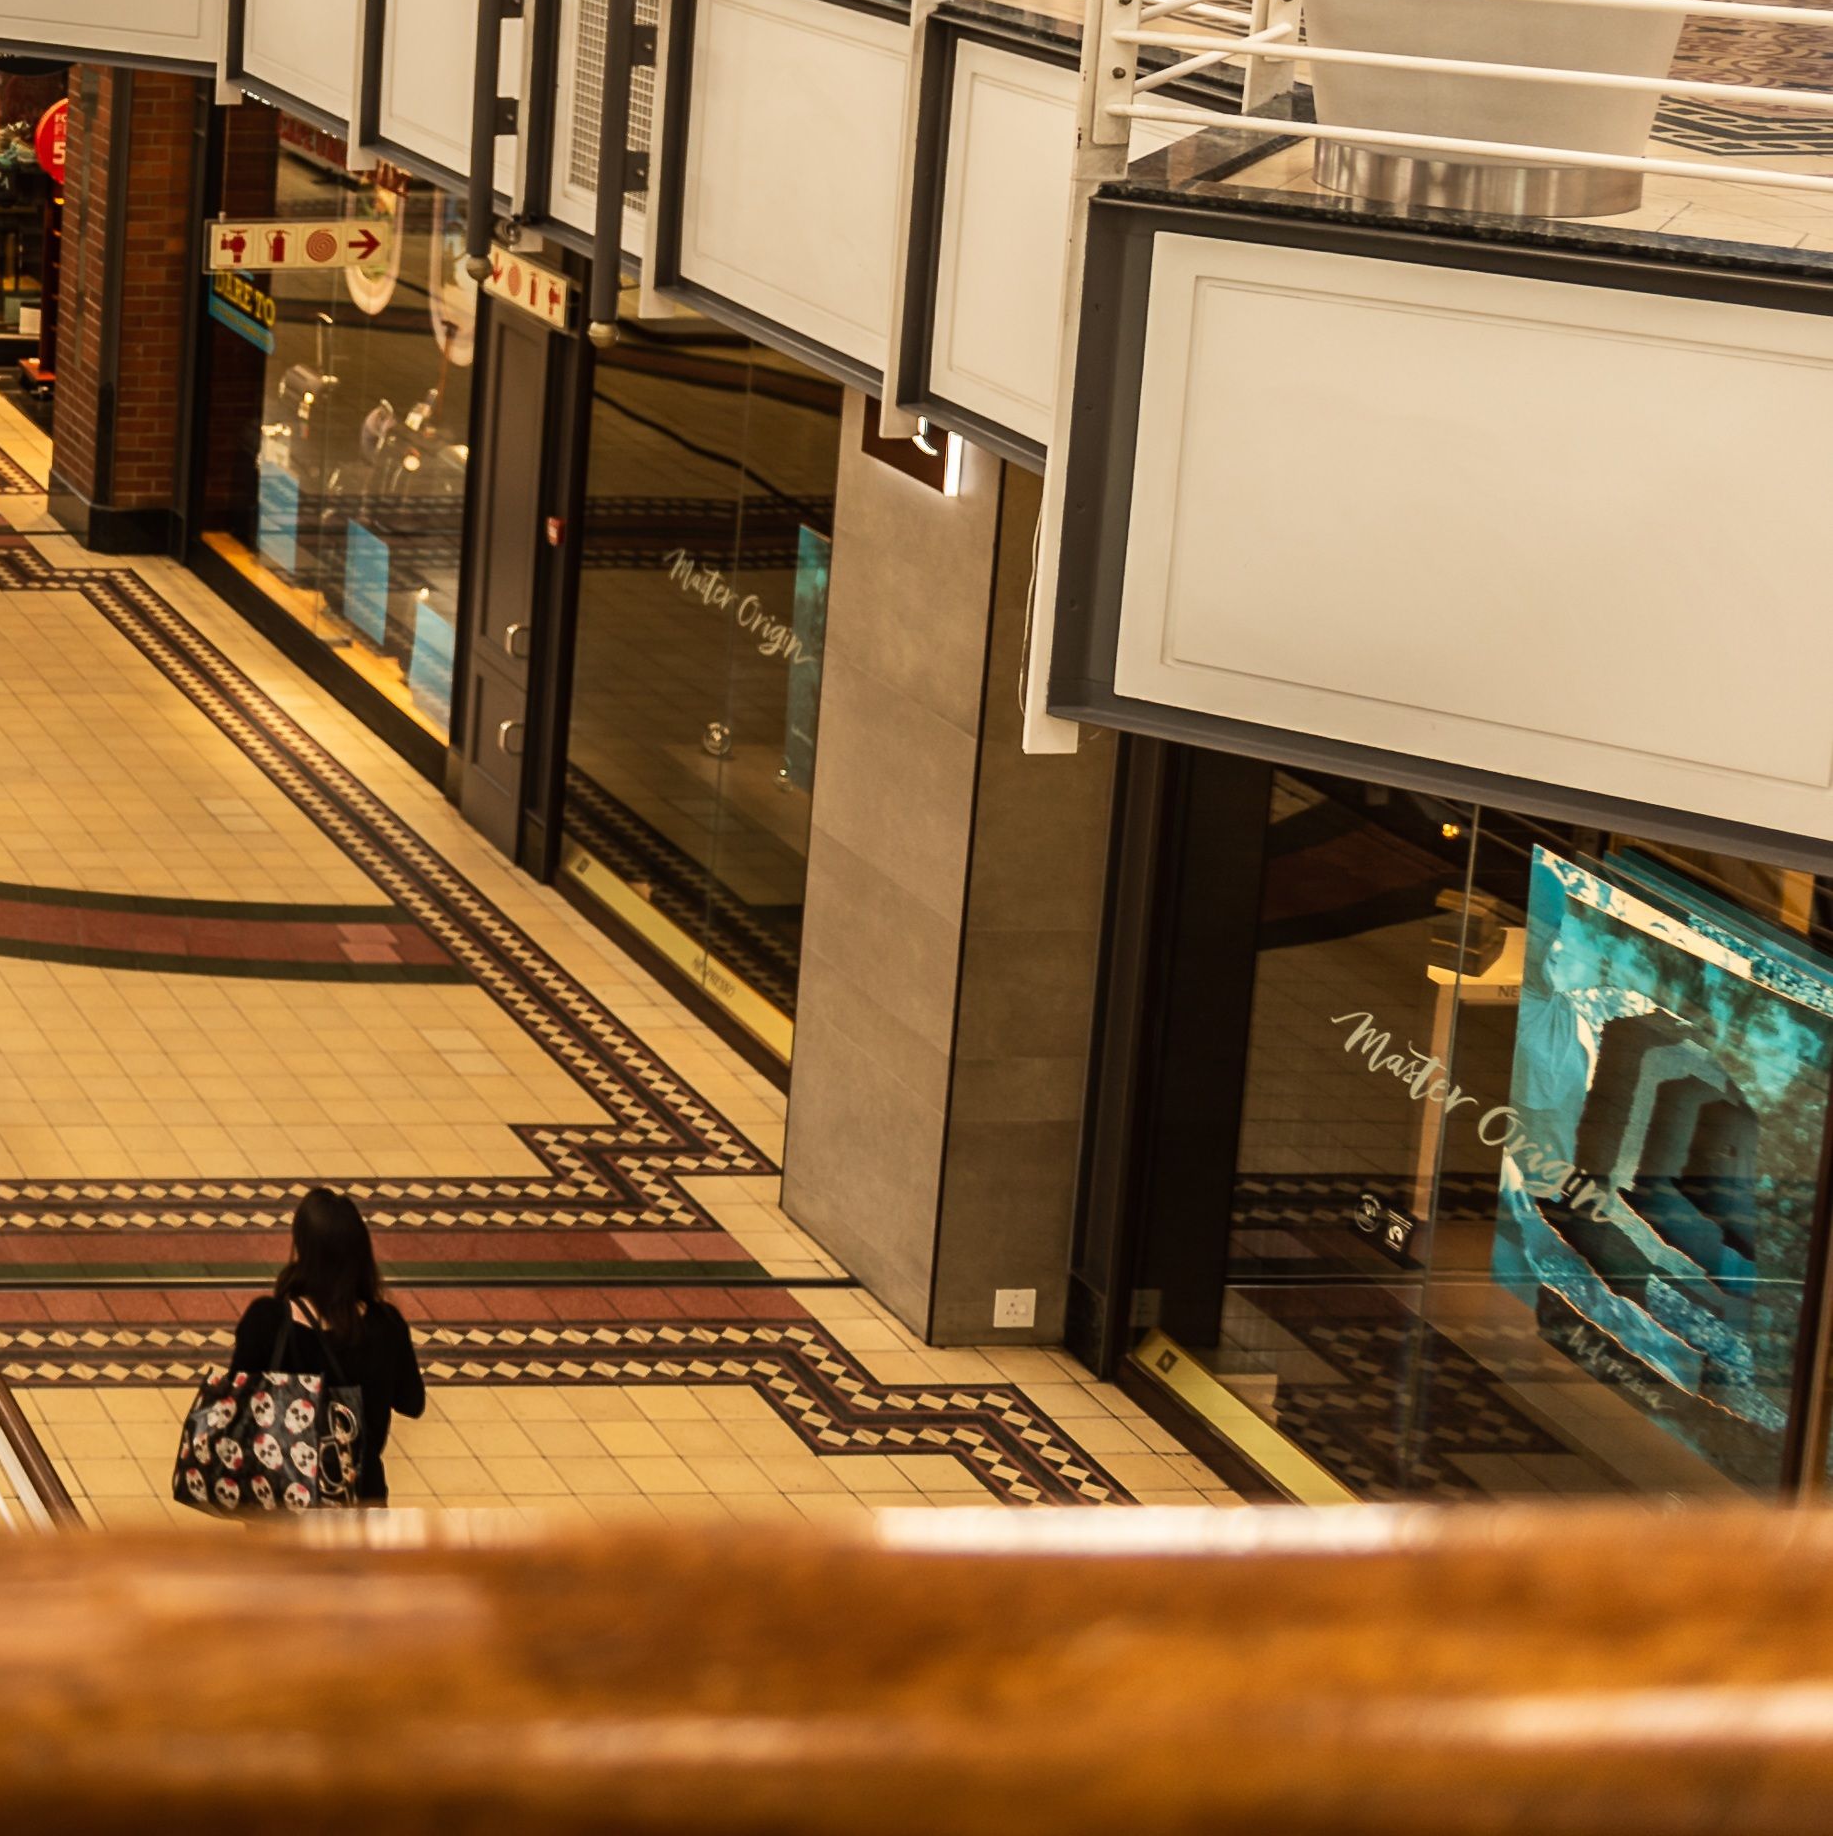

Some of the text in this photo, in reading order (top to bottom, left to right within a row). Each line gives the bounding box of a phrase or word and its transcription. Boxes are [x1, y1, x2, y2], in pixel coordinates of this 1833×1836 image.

[255, 291, 276, 327] TO
[663, 548, 817, 663] Master Origin
[1331, 1012, 1618, 1223] Master Origin
